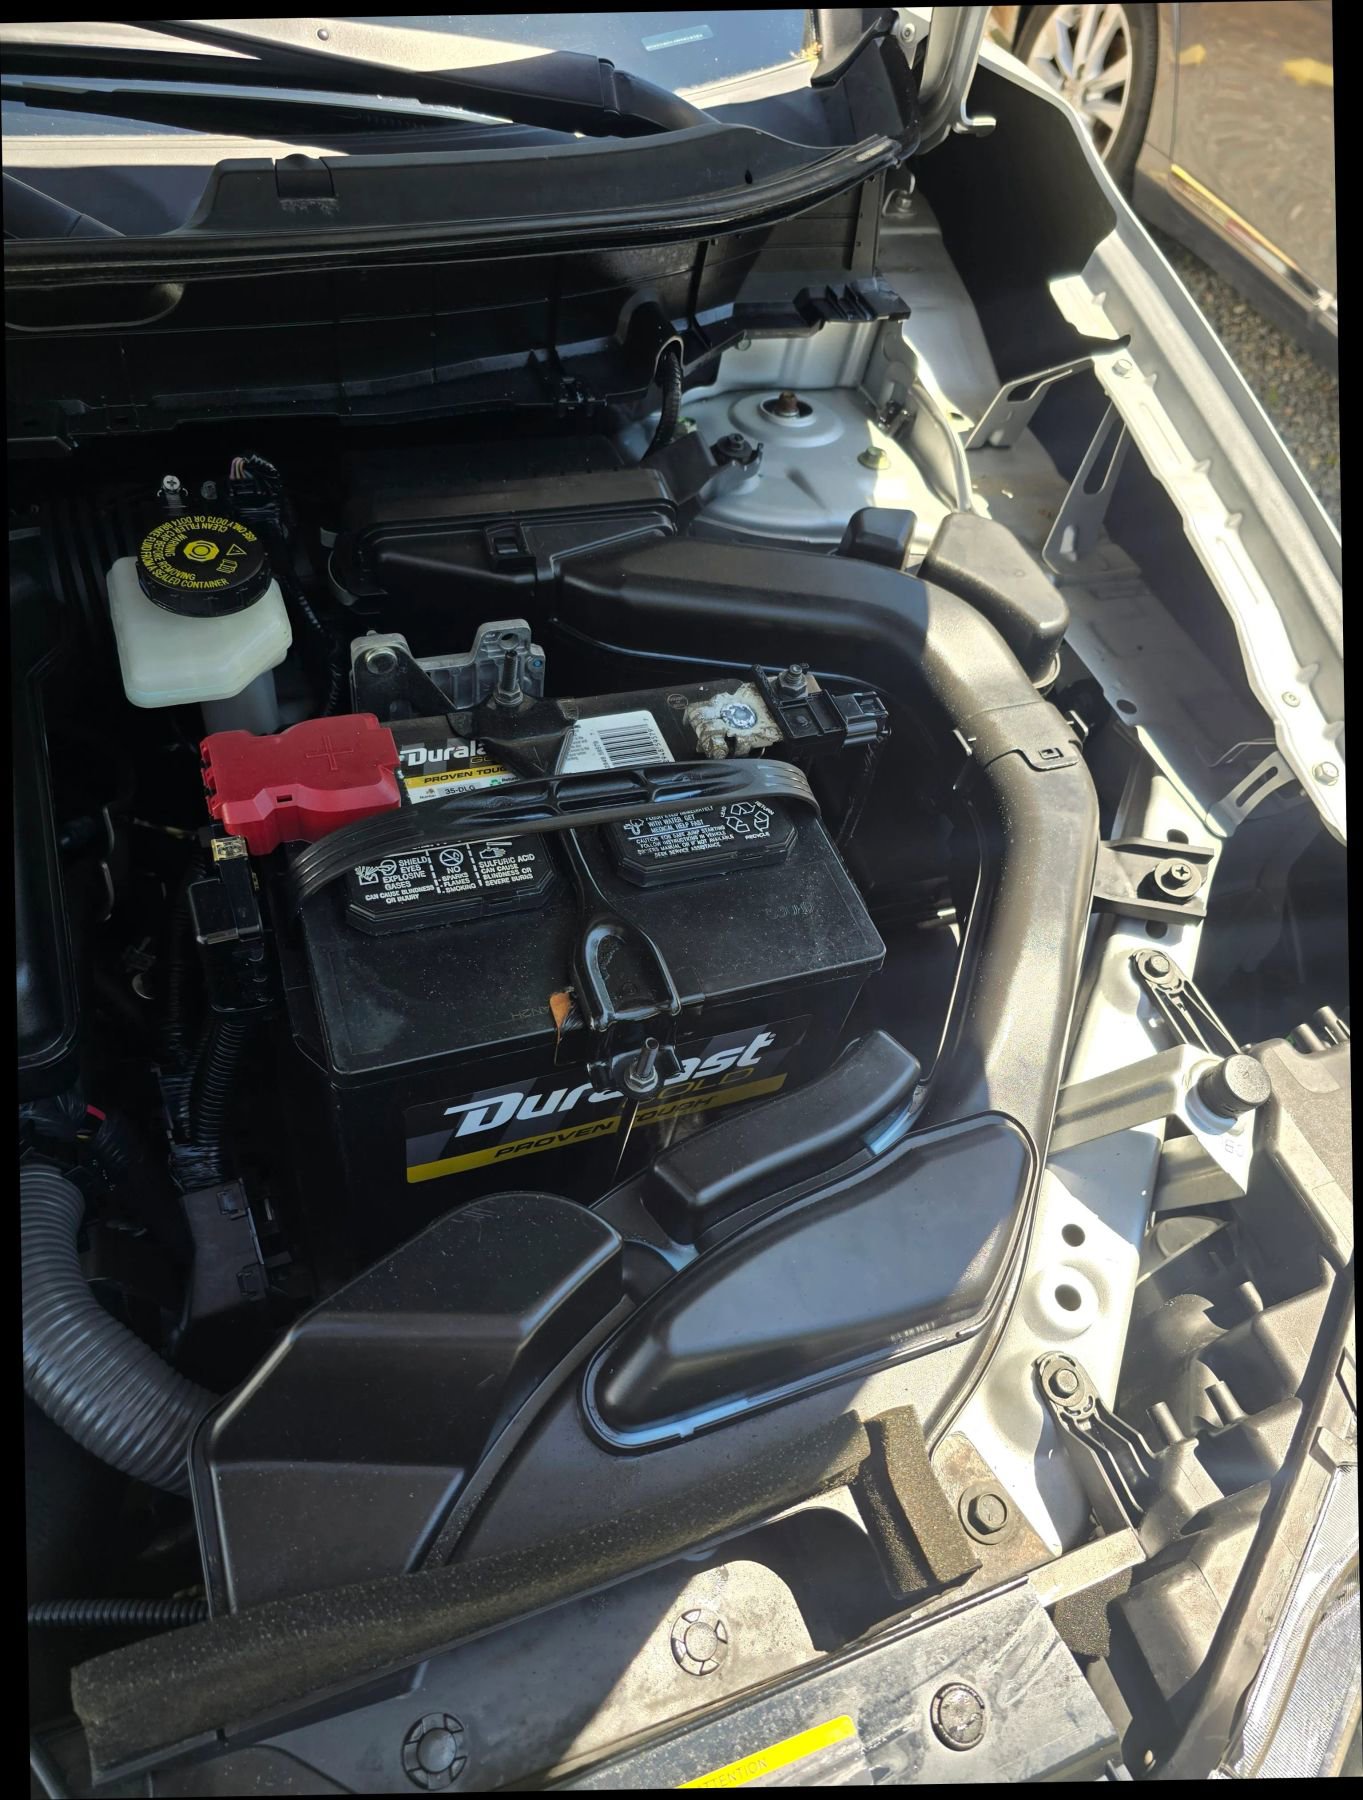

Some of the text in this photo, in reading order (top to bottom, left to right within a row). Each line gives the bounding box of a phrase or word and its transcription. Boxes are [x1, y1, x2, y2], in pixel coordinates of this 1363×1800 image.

[171, 516, 192, 526] DOT4
[194, 515, 206, 523] OR
[207, 515, 229, 525] DOT3
[149, 521, 173, 538] BRAKE
[153, 522, 228, 580] CLEAN FILLER CAP BEFORE REMOVING
[164, 534, 188, 557] WARNING
[152, 569, 181, 585] SEALED
[181, 578, 230, 589] CONTAINER
[424, 766, 510, 783] PROVEN TOUG
[675, 821, 690, 830] HELP
[691, 819, 704, 827] FAST
[398, 856, 428, 867] SHIELD
[478, 853, 535, 868] SULFURIC ACID
[400, 864, 422, 874] EYES
[446, 866, 461, 874] NO
[482, 866, 533, 880] BLINDNESS OR
[496, 863, 519, 872] CAUSE
[382, 870, 427, 883] EXPLOSIVE
[442, 872, 469, 881] SPARKS
[485, 873, 534, 887] SEVERE BURNS
[384, 880, 412, 890] GASES
[443, 878, 471, 887] FLAMES
[445, 883, 477, 893] SMOKING
[379, 890, 400, 899] CAUSE
[401, 884, 435, 895] BLINDNESS
[397, 894, 420, 902] INJURY
[622, 1068, 755, 1107] OLD
[494, 1096, 718, 1158] PROVEN OUGH
